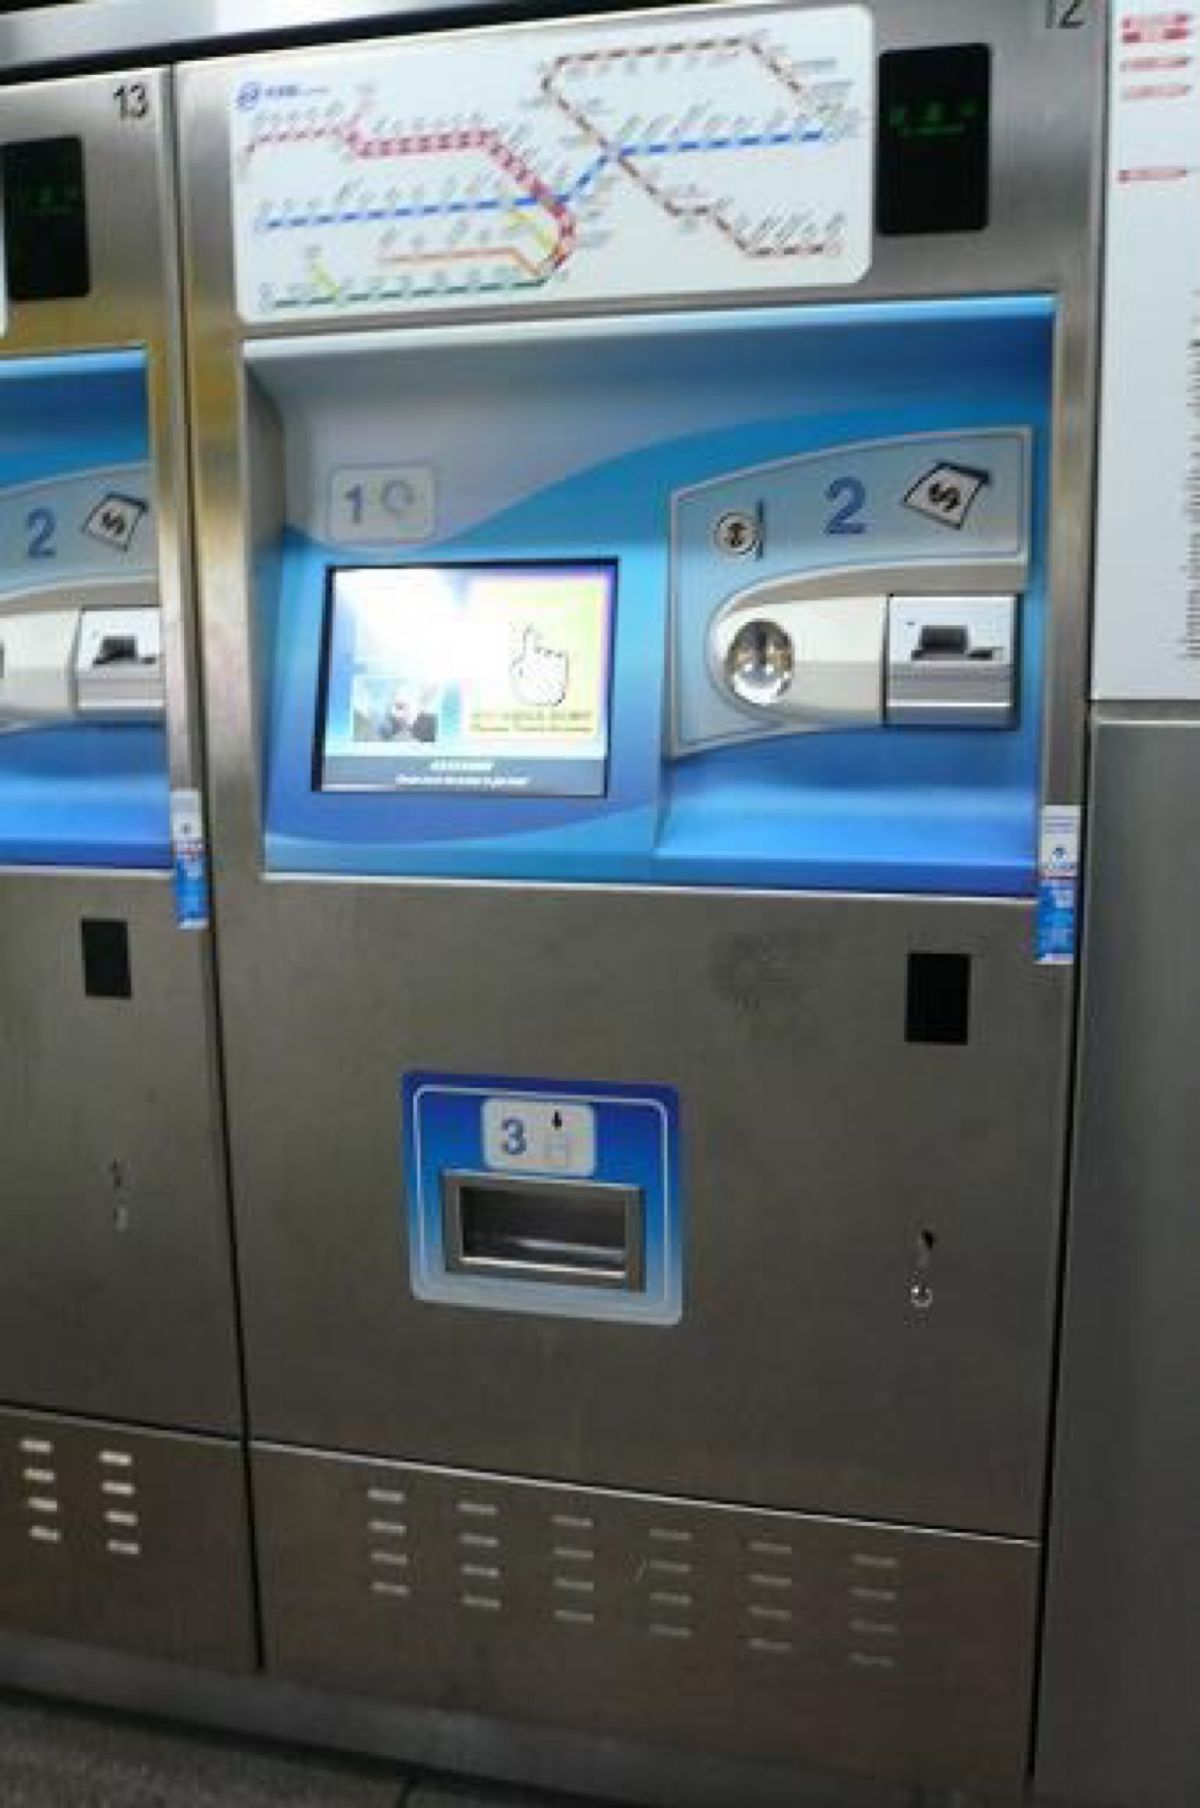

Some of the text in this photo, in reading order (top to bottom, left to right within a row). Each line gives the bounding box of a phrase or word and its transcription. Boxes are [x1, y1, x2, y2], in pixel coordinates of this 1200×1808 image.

[113, 84, 148, 118] 13
[343, 483, 363, 524] 1
[823, 475, 867, 535] 2
[27, 508, 57, 558] 2
[500, 1116, 527, 1156] 3
